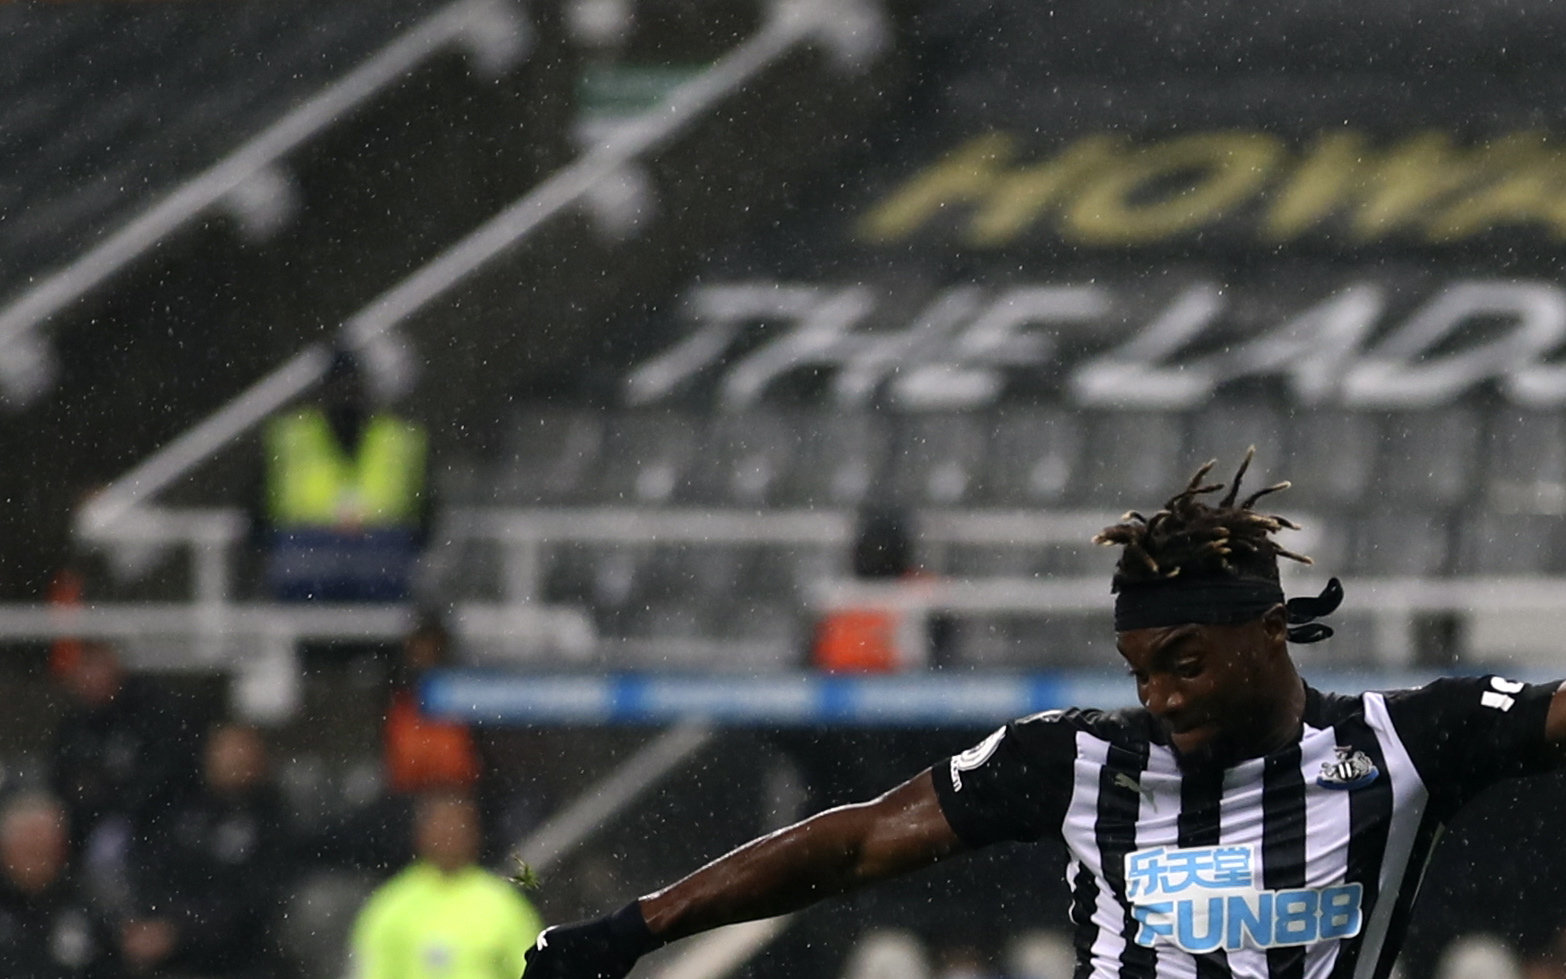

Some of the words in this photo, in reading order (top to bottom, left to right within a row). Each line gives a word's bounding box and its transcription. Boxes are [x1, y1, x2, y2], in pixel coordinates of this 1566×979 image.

[624, 280, 1110, 406] THE
[1128, 847, 1252, 897] 乐天堂
[1132, 884, 1361, 951] FUN88
